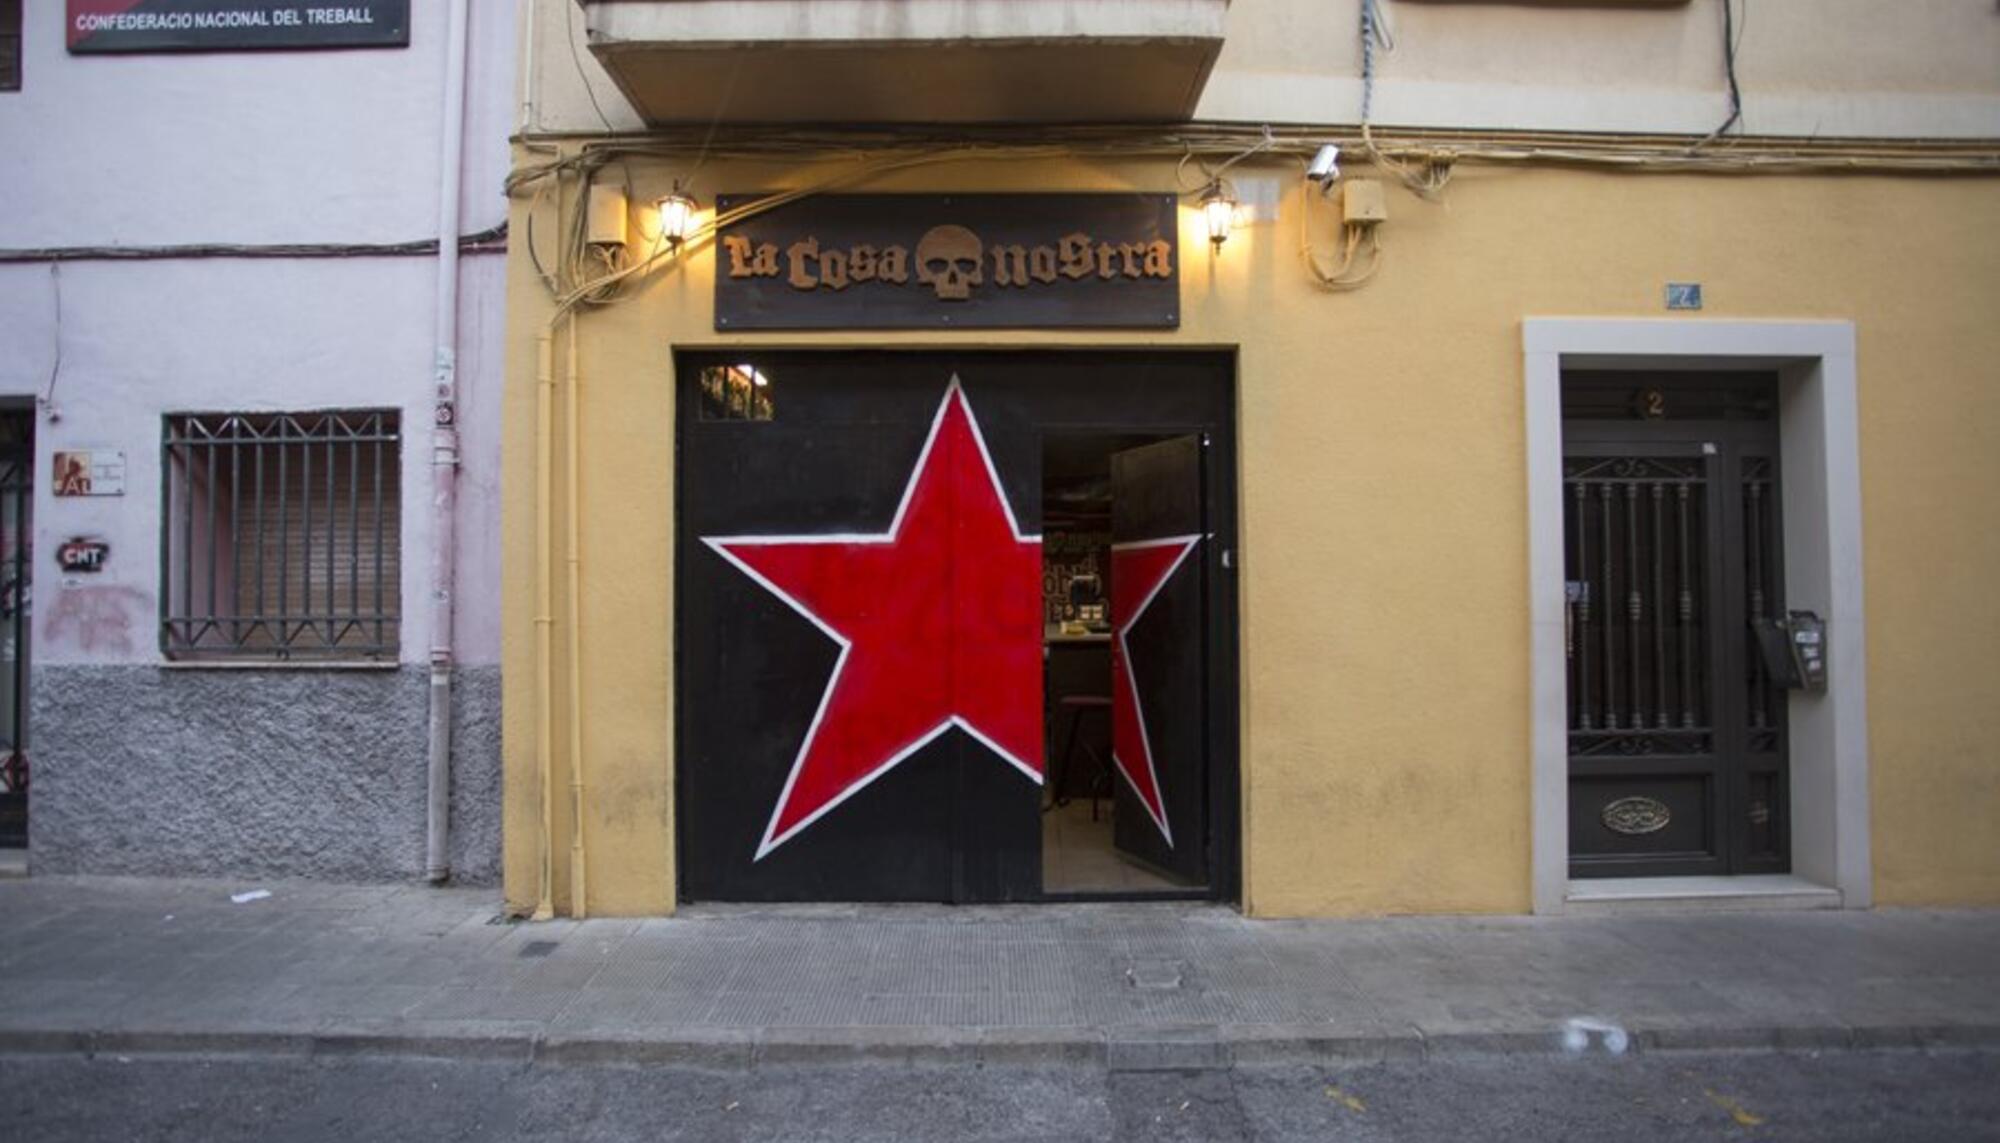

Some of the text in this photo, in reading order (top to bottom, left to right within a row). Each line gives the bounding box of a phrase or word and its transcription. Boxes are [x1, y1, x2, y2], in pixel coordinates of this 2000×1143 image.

[75, 7, 373, 31] CONFEDERACIO NACIONAL DEL TREBALL
[723, 234, 780, 278] La
[786, 235, 909, 290] Cosa
[1648, 391, 1663, 414] 2
[63, 548, 101, 564] CNT
